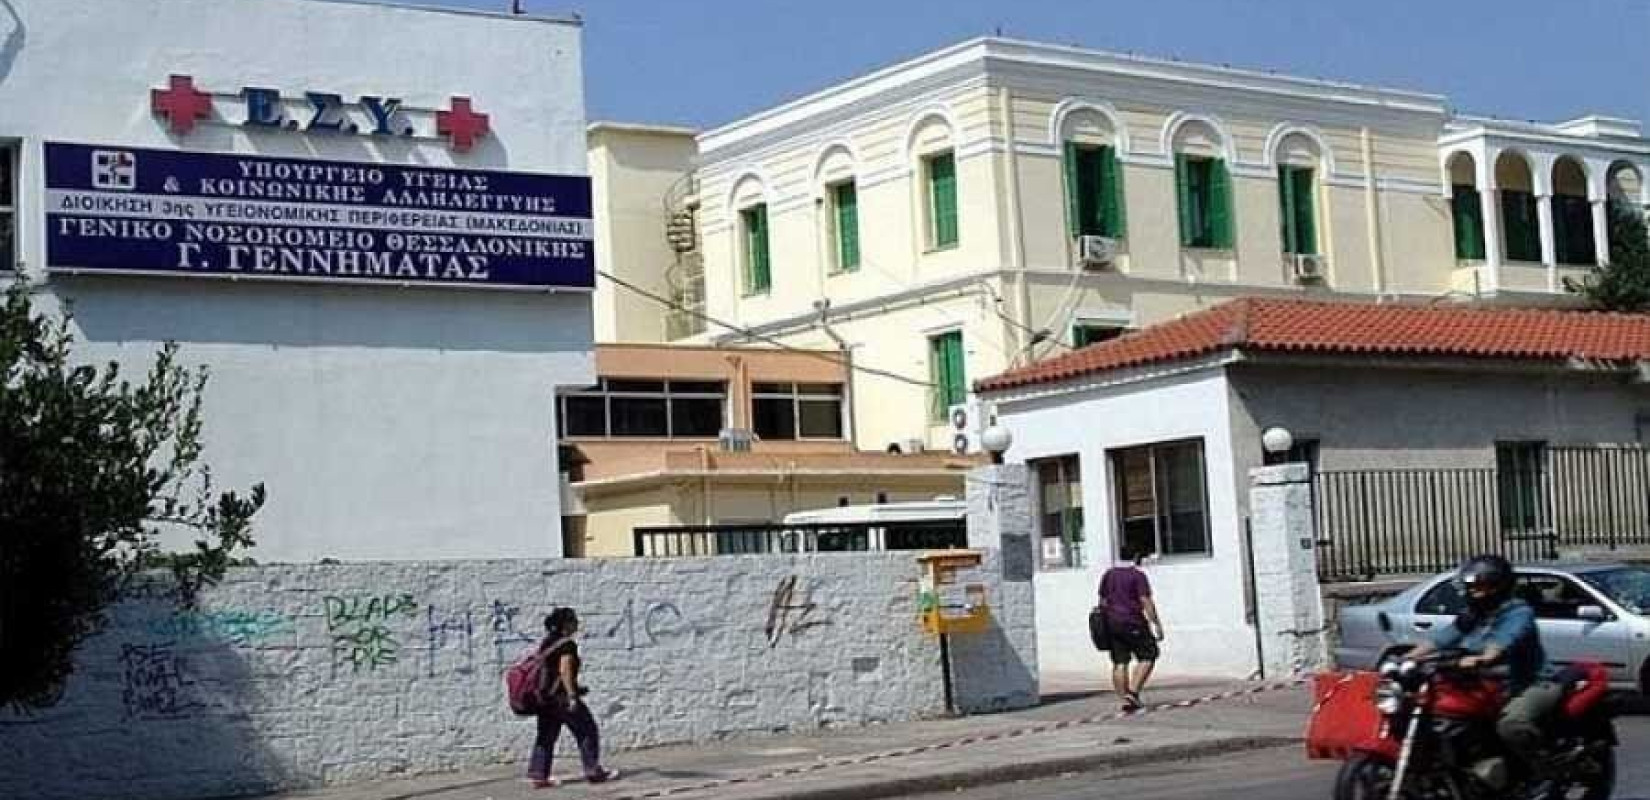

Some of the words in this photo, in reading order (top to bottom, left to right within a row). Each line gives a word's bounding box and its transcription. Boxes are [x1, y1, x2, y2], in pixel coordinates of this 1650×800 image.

[238, 160, 384, 184] ΥΠΟΥΡΓΕΙΟ
[402, 171, 489, 191] ΥΓΕΙΑΣ
[163, 176, 181, 193] &
[200, 178, 366, 202] ΚΟΙΝΩΝΙΚΗΣ
[382, 189, 556, 213] ΑΛΛΗΛΕΓΓΥΗΣ
[61, 195, 153, 213] ΔΙΟΙΚΗΣΗ
[162, 201, 195, 218] 3ης
[204, 203, 339, 223] ΥΓΕΙΟΝΟΜΙΚΗΣ
[349, 209, 457, 228] ΠΕΡΙΦΕΡΕΙΑΣ
[466, 215, 583, 236] (ΜΑΚΕΔΟΝΙΑΣ)
[59, 217, 173, 240] ΓΕΝΙΚΟ
[185, 223, 375, 249] ΝΟΣΟΚΟΜΕΙΟ
[385, 232, 586, 259] ΘΕΣΣΑΛΟΝΙΚΗΣ
[176, 242, 210, 268] Γ.
[226, 245, 490, 279] ΓΕΝΝΗΜΑΤΑΣ
